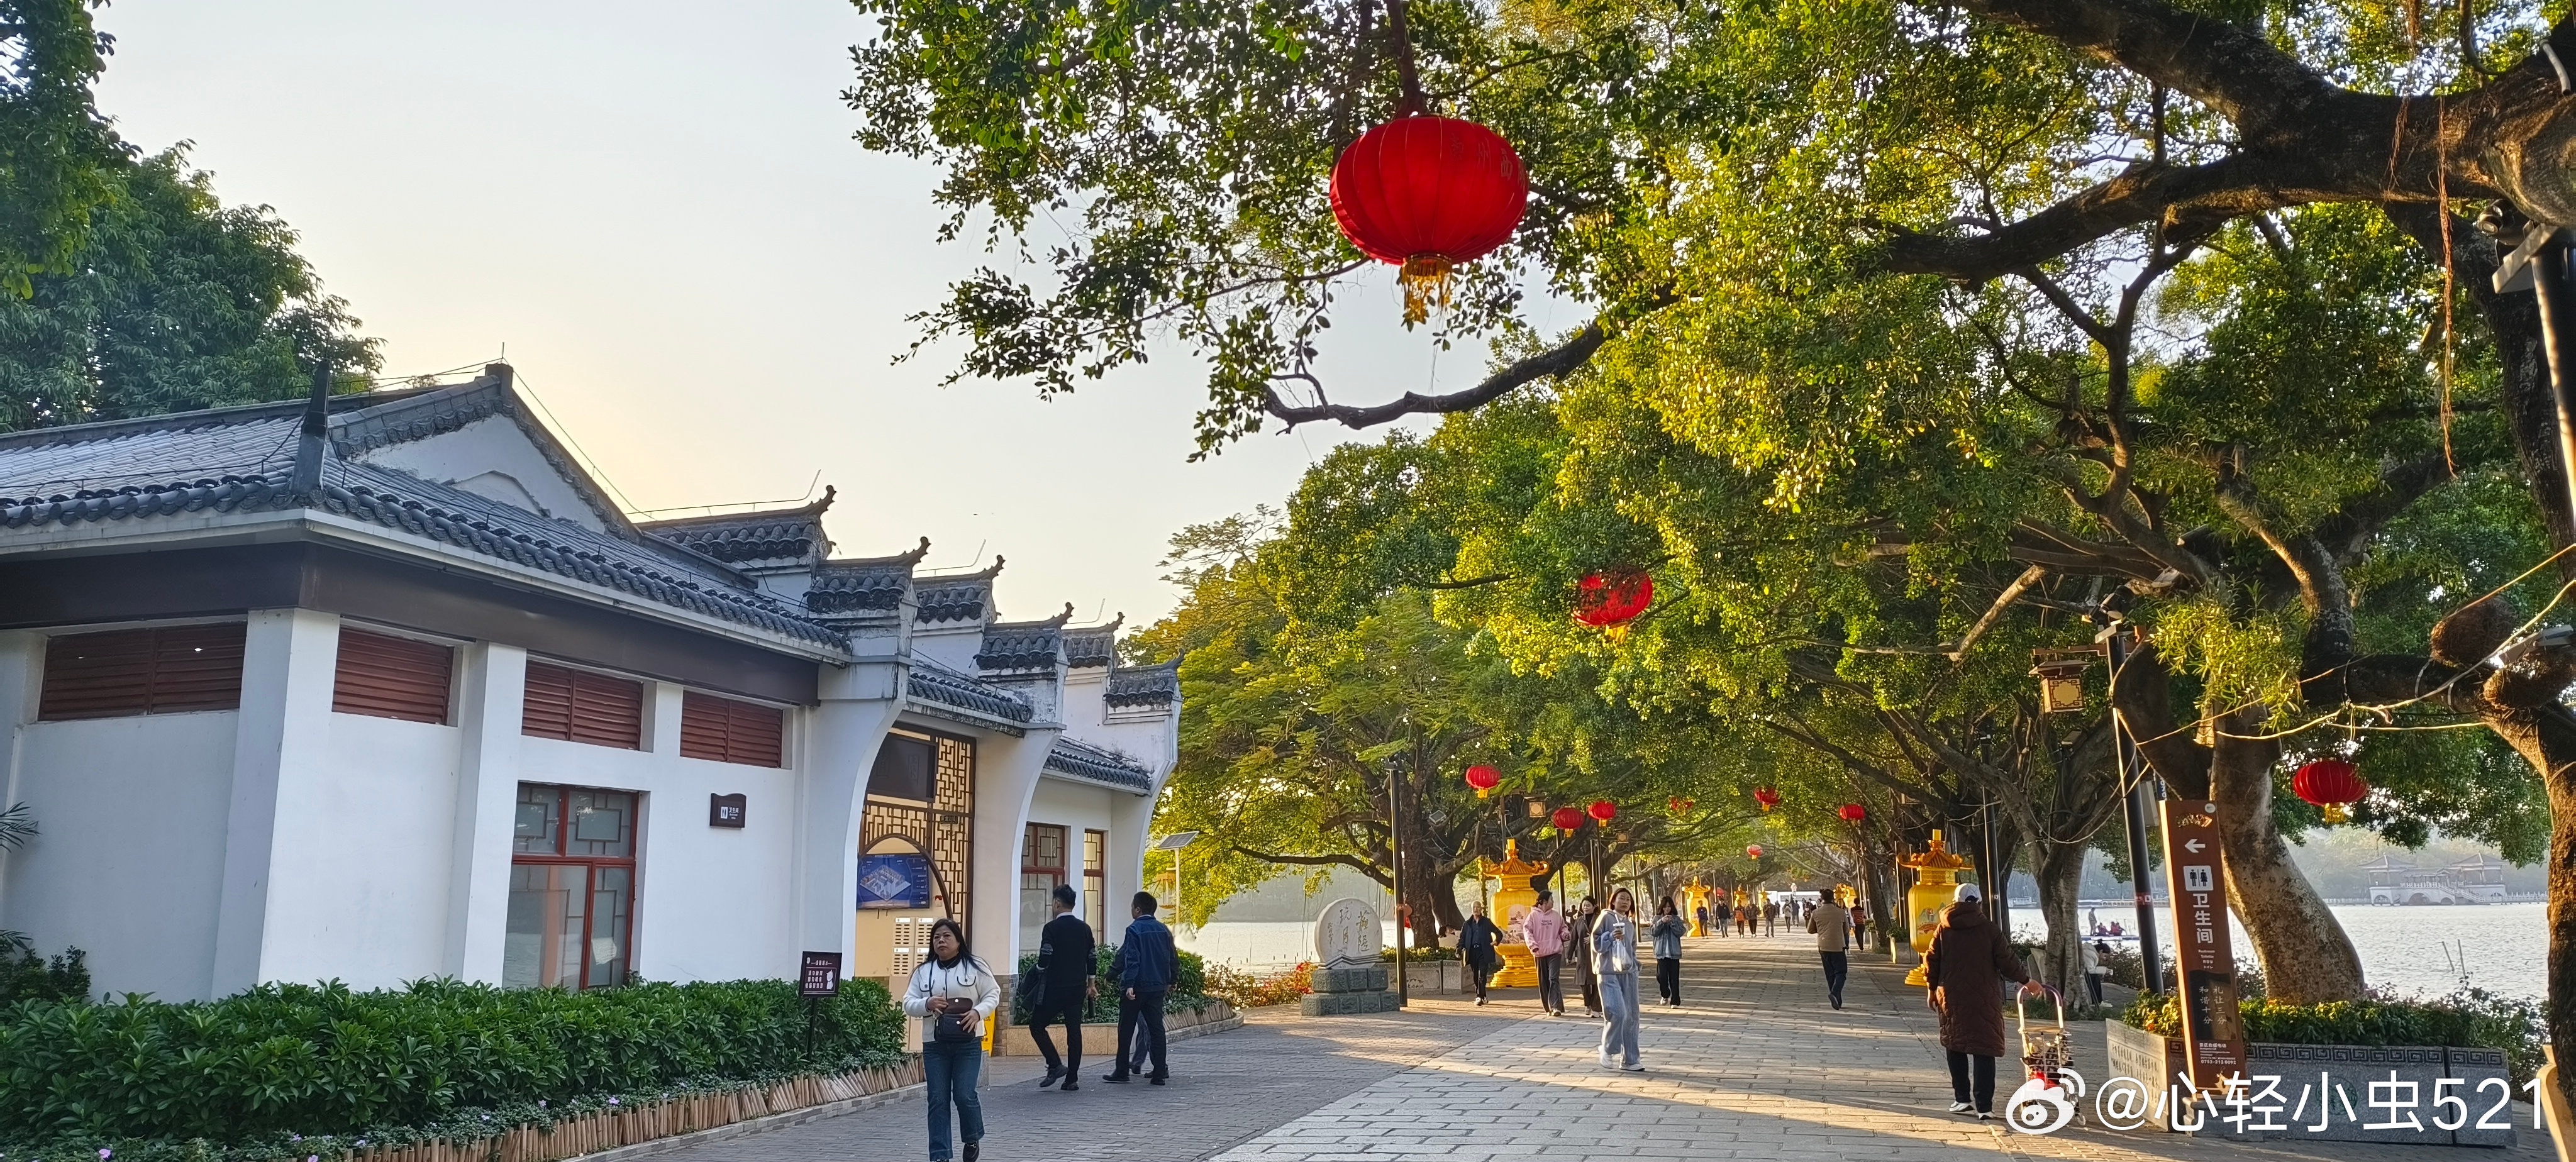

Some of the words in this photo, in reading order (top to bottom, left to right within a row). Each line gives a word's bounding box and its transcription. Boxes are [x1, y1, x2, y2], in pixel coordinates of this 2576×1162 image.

[2193, 893, 2213, 944] 卫生间
[2199, 985, 2213, 1024] 和谐十分
[2213, 985, 2227, 1025] 礼让三分
